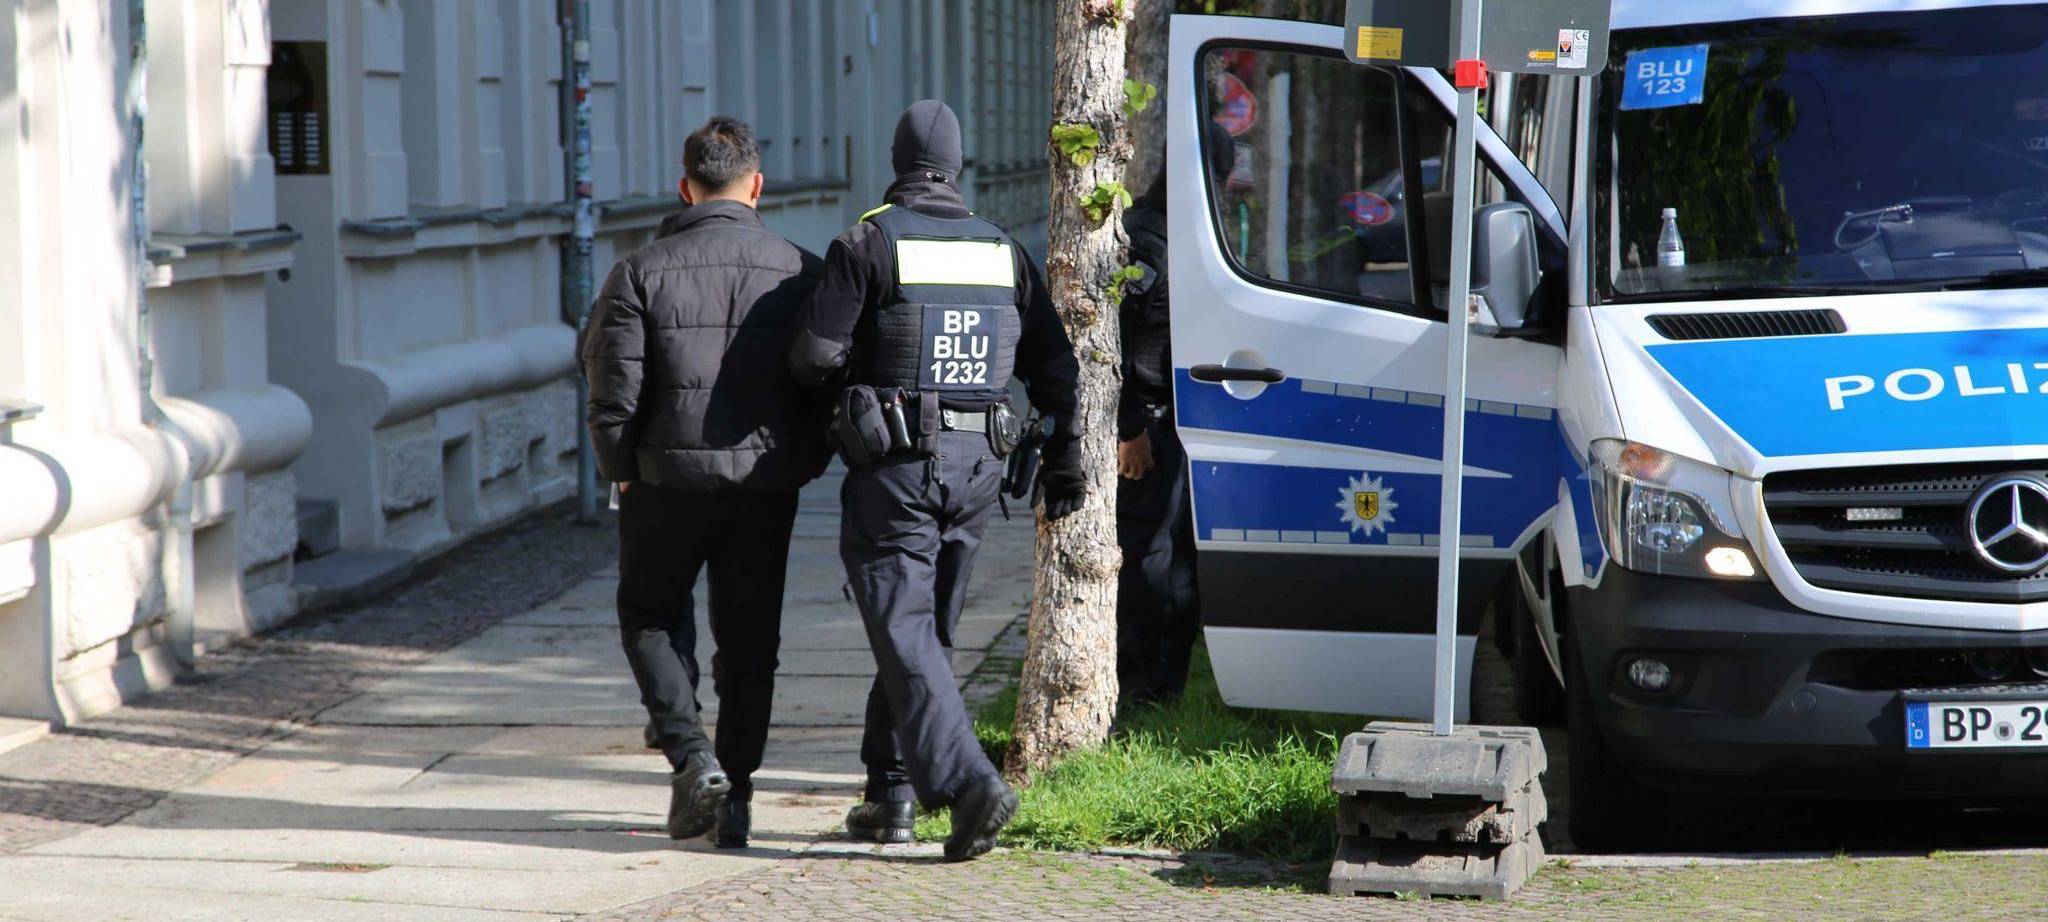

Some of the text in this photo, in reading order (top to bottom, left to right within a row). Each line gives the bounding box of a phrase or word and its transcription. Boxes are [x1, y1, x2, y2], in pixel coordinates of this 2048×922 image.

[1638, 59, 1693, 78] BLU
[1643, 78, 1686, 95] 123
[944, 310, 980, 333] BP
[934, 336, 988, 359] BLU
[931, 361, 987, 384] 1232
[1914, 729, 1924, 740] D
[1943, 707, 2048, 741] BP 2
